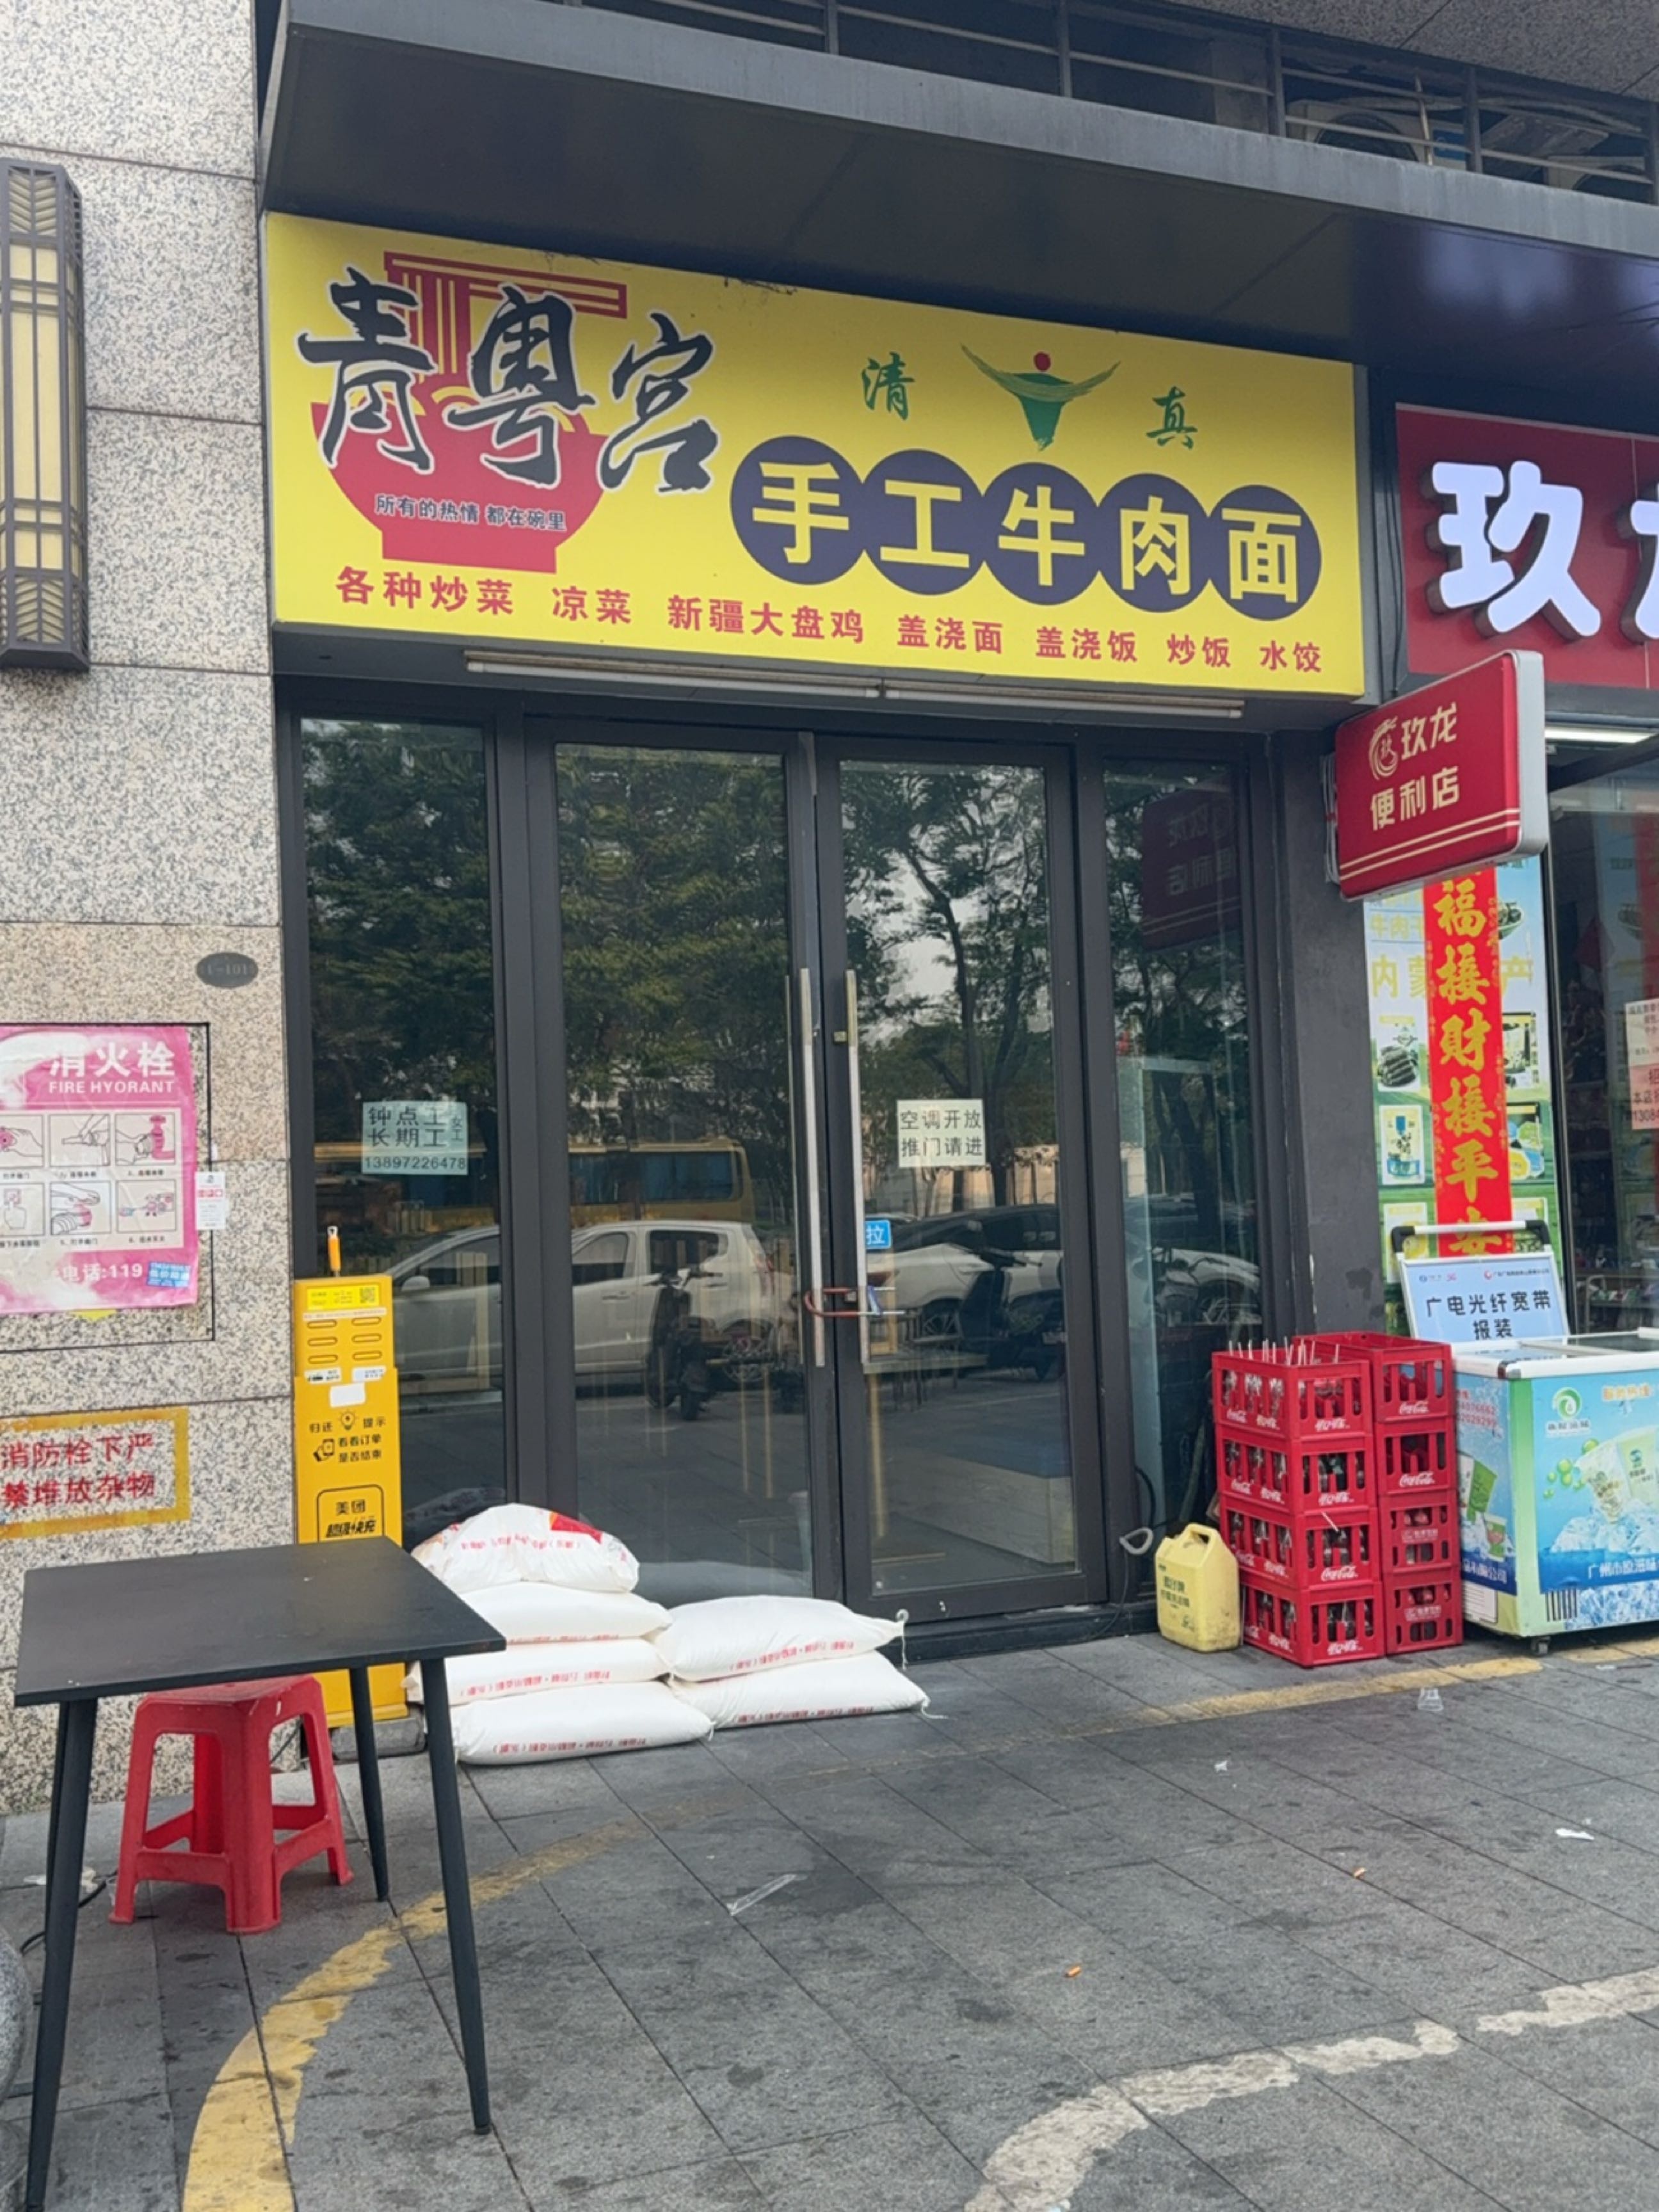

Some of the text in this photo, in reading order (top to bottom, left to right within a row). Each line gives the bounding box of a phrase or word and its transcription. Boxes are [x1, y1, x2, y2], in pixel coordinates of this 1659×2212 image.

[862, 351, 1198, 450] 清 真
[374, 493, 567, 532] 所有的热情 都在碗里
[751, 461, 1302, 604] 手工牛肉面
[1432, 460, 1659, 640] 玖
[335, 566, 1322, 673] 各种炒菜 凉菜 新疆大盘鸡 盖浇面 盖浇饭 炒饭 水饺
[1400, 701, 1457, 761] 玖龙
[1370, 765, 1460, 831] 便利店
[1432, 871, 1503, 1256] 福接財接平安
[49, 1080, 86, 1094] FIRE
[368, 1105, 447, 1126] 钟点工
[900, 1109, 982, 1130] 空调开放
[367, 1128, 447, 1148] 长期工
[901, 1136, 983, 1158] 推门请进
[865, 1225, 885, 1245] 拉
[1425, 1289, 1551, 1317] 广电光纤宽带
[1472, 1317, 1514, 1340] 报装
[1, 1432, 154, 1470] 消防栓下严
[4, 1470, 156, 1509] 禁堆放杂物
